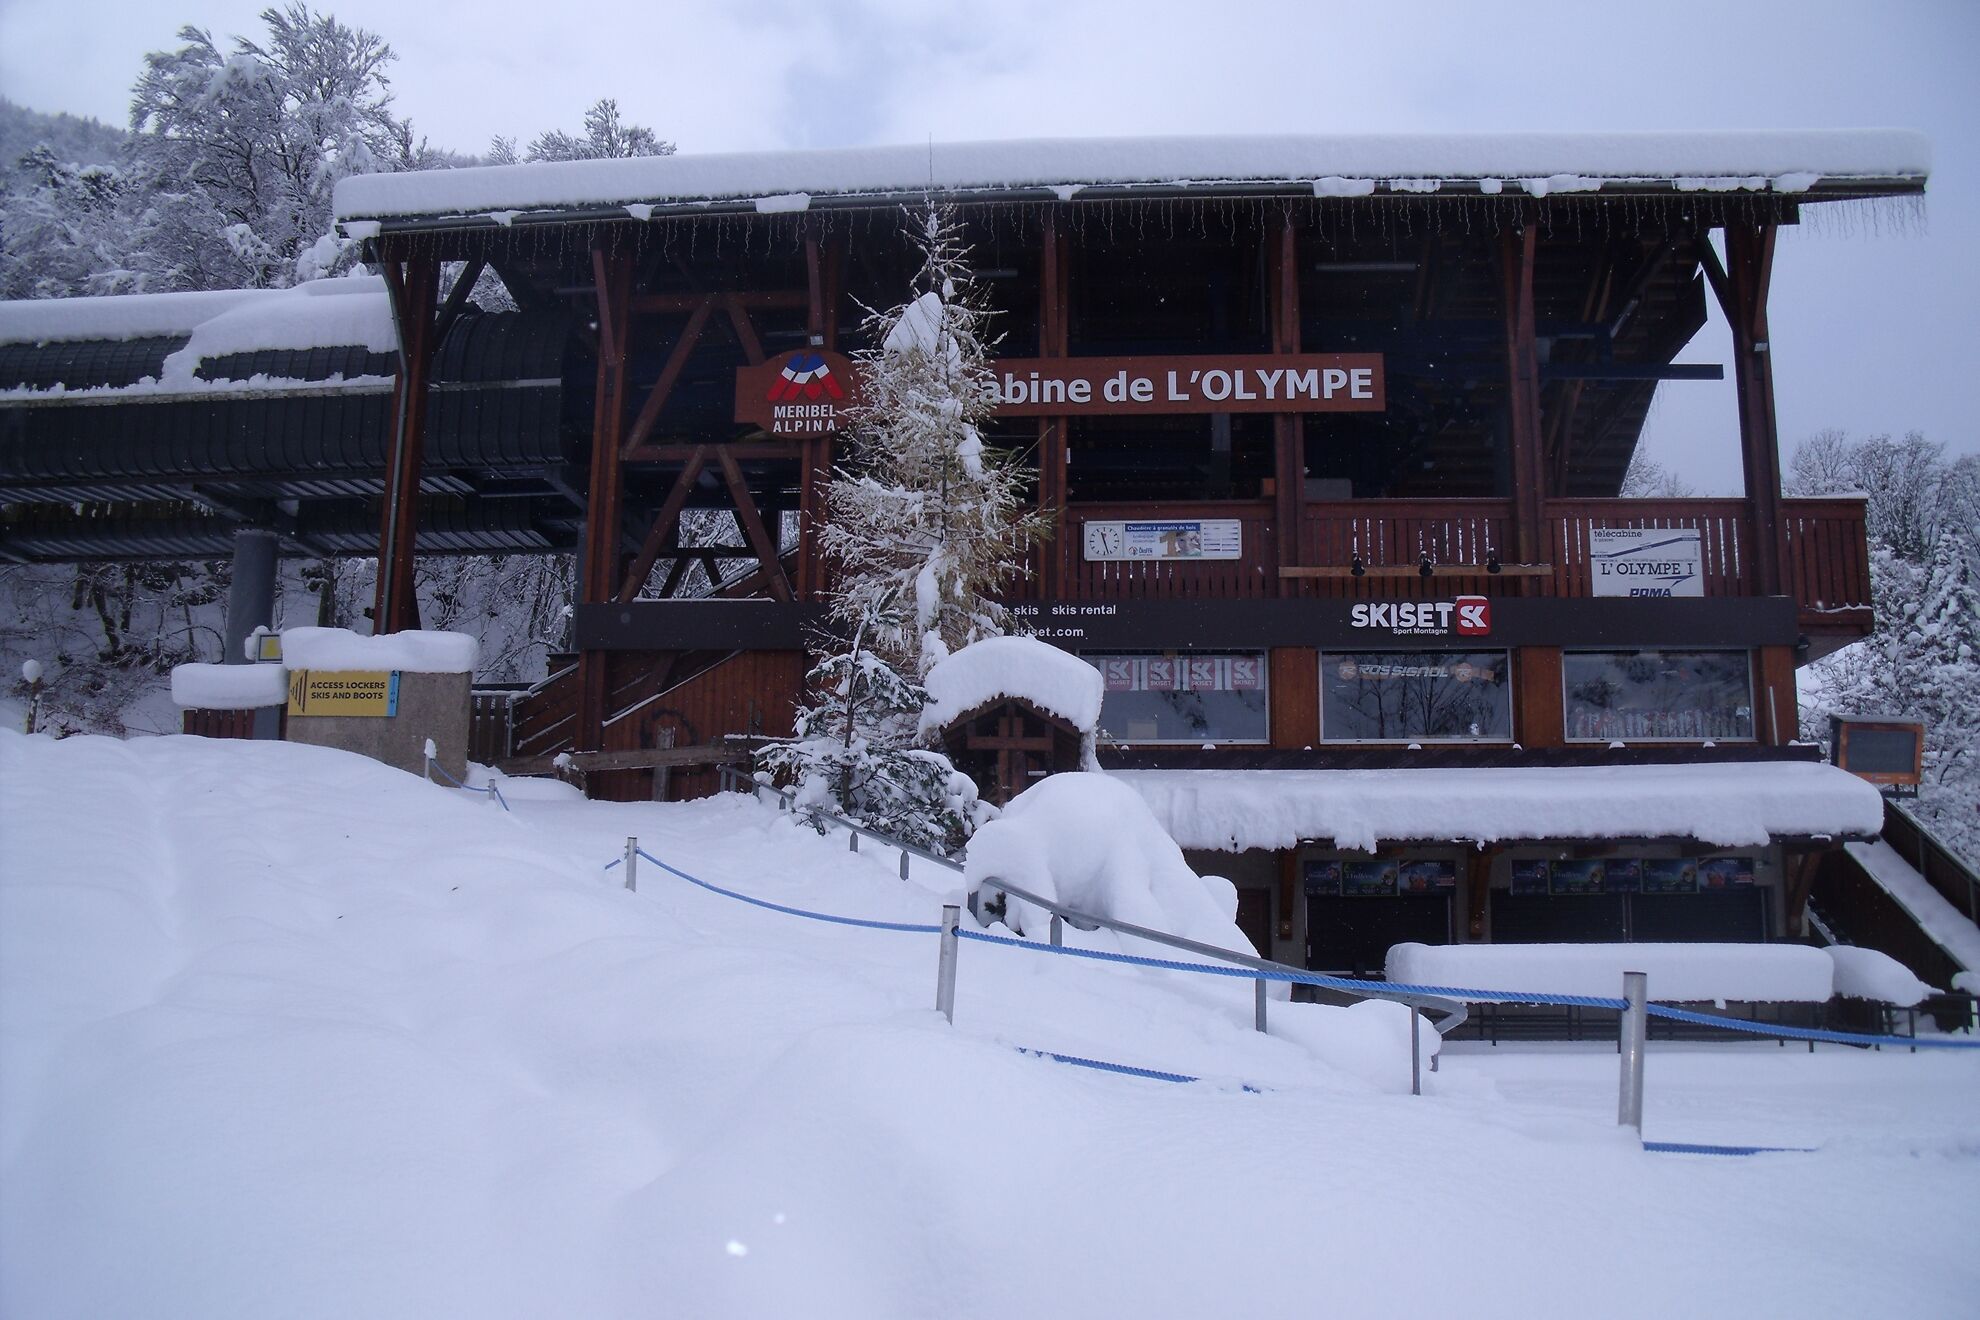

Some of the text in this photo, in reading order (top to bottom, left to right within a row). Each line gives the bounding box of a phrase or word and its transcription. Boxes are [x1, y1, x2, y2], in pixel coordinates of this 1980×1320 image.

[977, 371, 1092, 404] abine
[1103, 370, 1154, 402] de
[773, 404, 837, 419] MERIBEL
[772, 420, 836, 433] ALPINA
[1014, 605, 1039, 615] skis
[1052, 604, 1077, 615] skis
[1080, 604, 1116, 615] rental
[1351, 602, 1454, 628] SKISET
[1392, 627, 1448, 636] Sport Montagne
[310, 681, 385, 689] ACCESS LOCKERS
